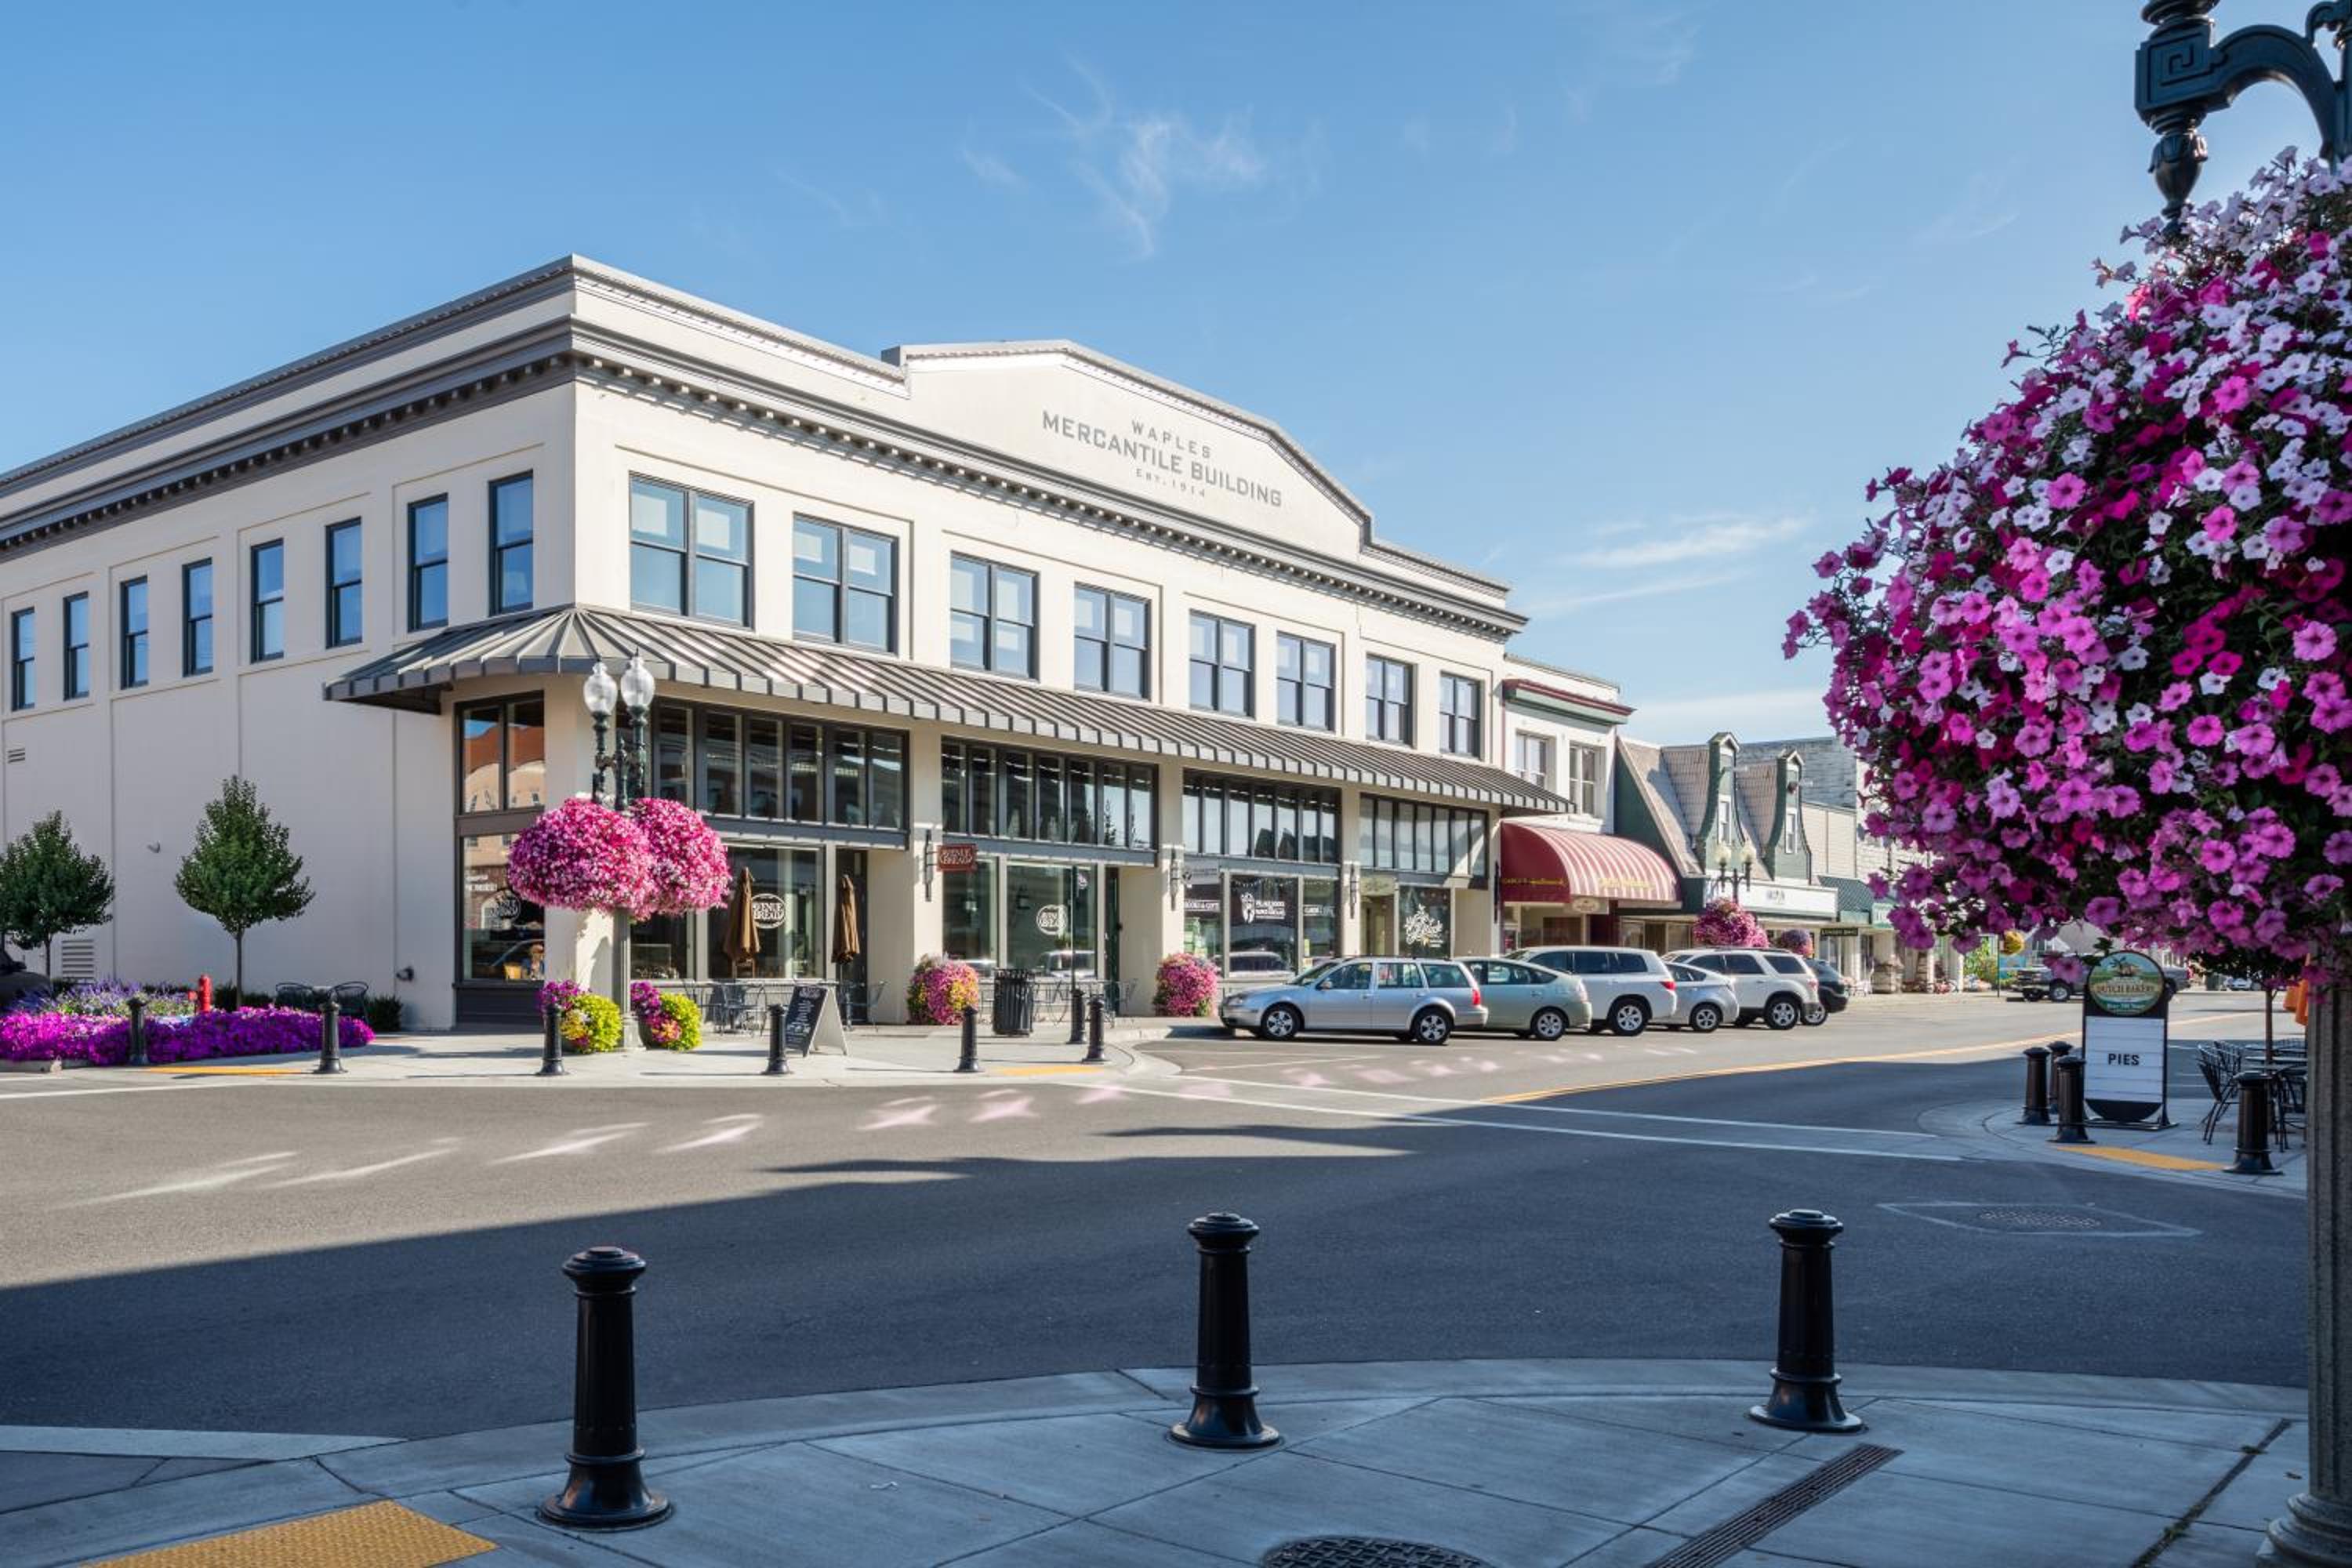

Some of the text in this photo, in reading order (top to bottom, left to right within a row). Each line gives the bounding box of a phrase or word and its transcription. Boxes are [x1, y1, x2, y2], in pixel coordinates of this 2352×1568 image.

[1131, 420, 1212, 459] WAPLES
[1042, 410, 1283, 506] MERCANTILE BUILDING
[1172, 479, 1205, 497] 1914
[2108, 1053, 2140, 1066] PIES
